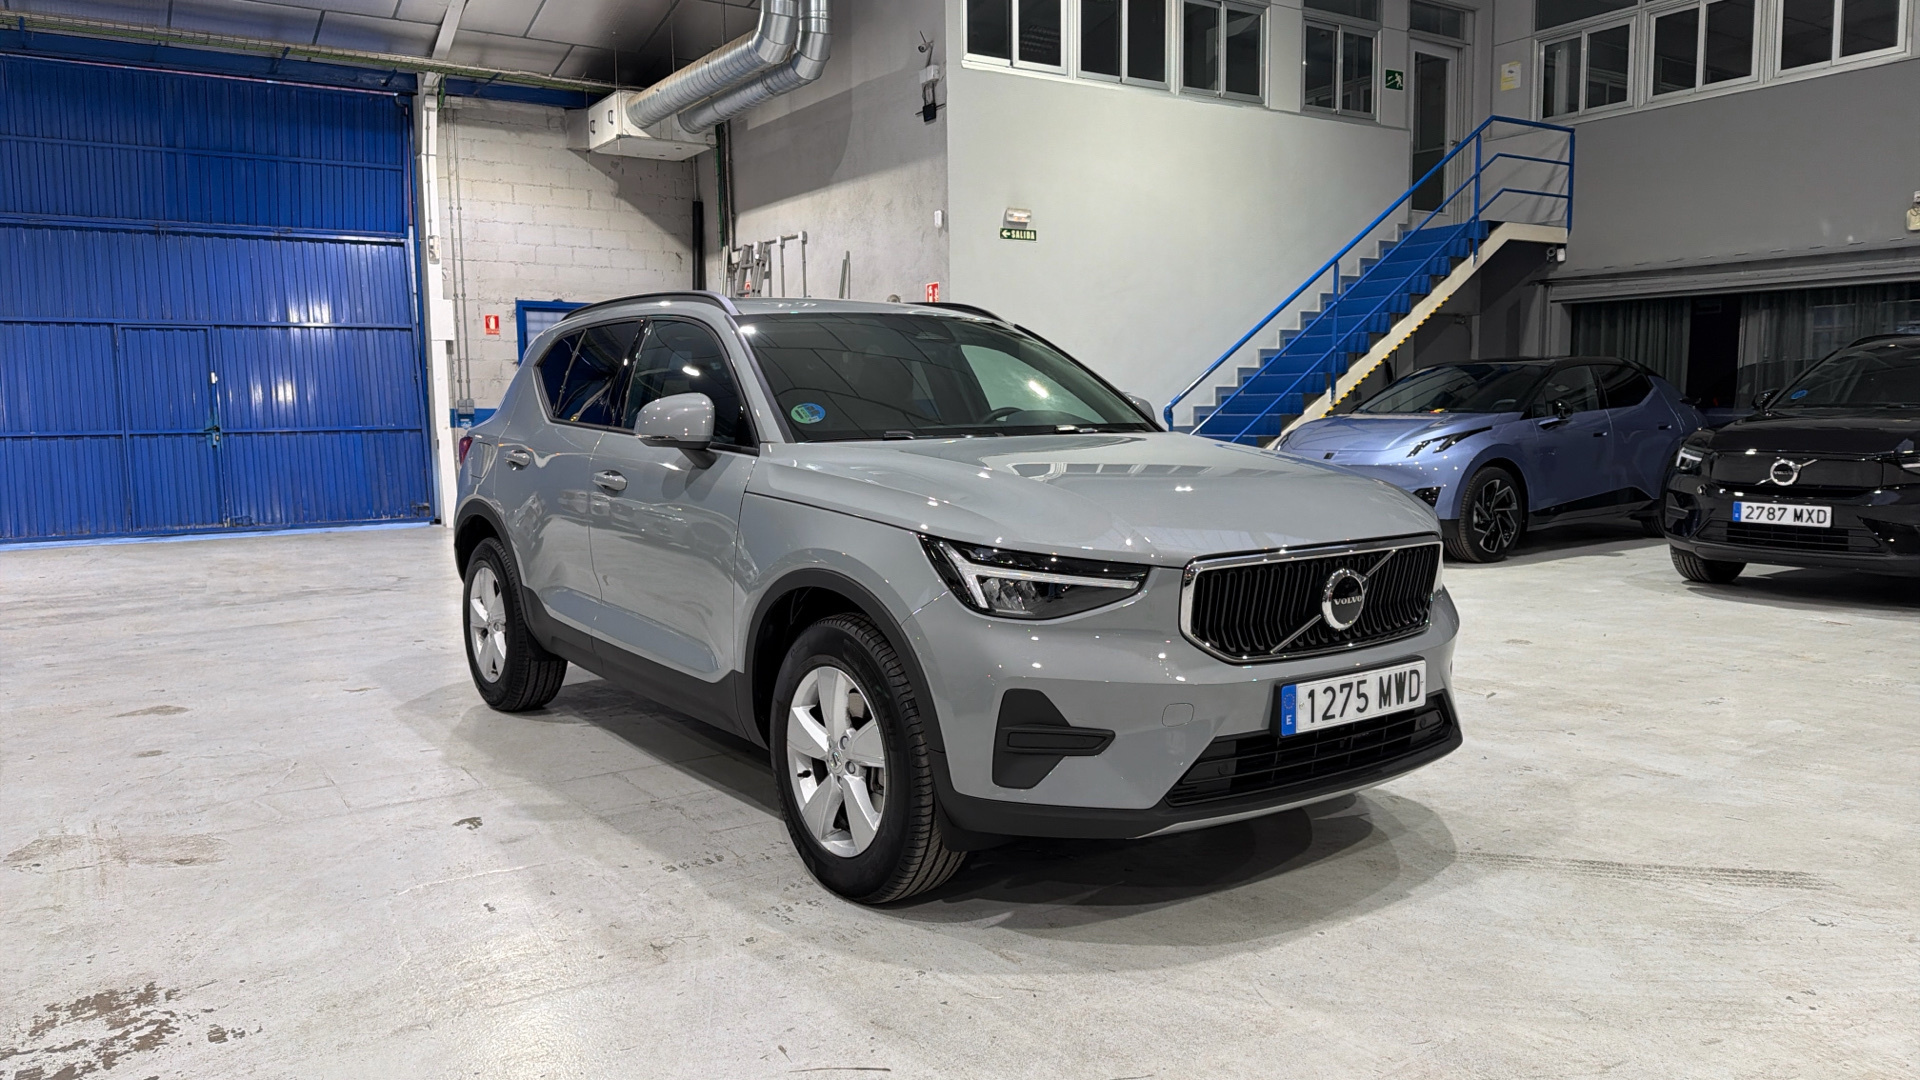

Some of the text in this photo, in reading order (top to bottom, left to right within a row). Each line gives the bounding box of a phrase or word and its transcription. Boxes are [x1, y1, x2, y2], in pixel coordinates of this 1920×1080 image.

[1011, 230, 1035, 239] SALIDA
[1745, 505, 1827, 524] 2787 MXD
[1333, 595, 1362, 605] VOLVO
[1307, 669, 1421, 723] 1275 MWD
[1286, 714, 1293, 725] E
